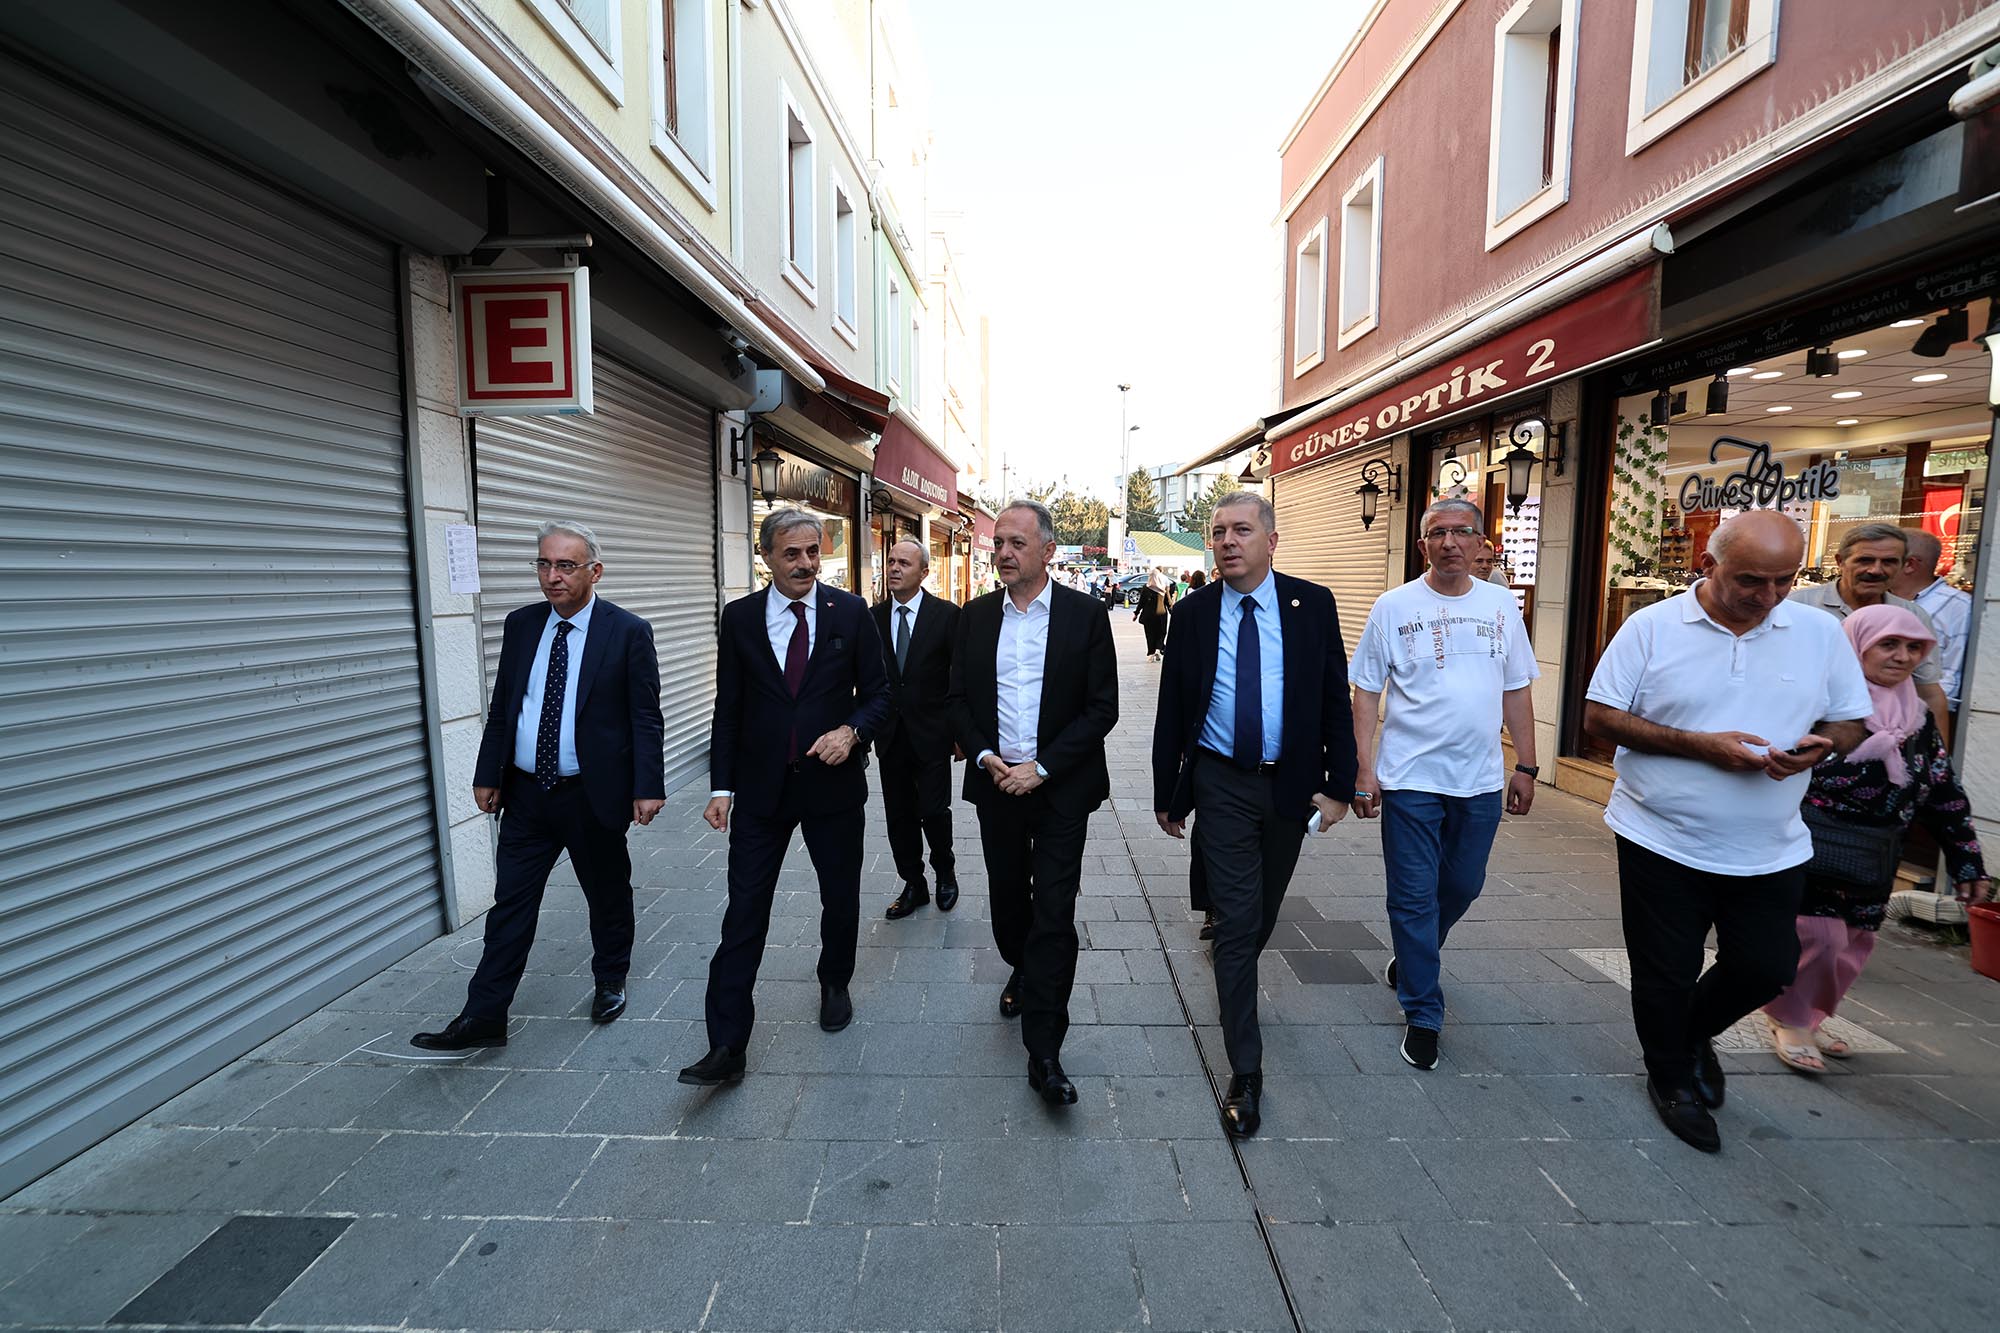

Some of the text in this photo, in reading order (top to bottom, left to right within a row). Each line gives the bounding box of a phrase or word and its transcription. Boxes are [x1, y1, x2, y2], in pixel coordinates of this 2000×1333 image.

[1926, 271, 1998, 302] VOGUE
[485, 298, 553, 384] E
[1376, 359, 1508, 430] OPTİK
[1526, 338, 1555, 378] 2
[1680, 461, 1839, 512] Güneş Optik
